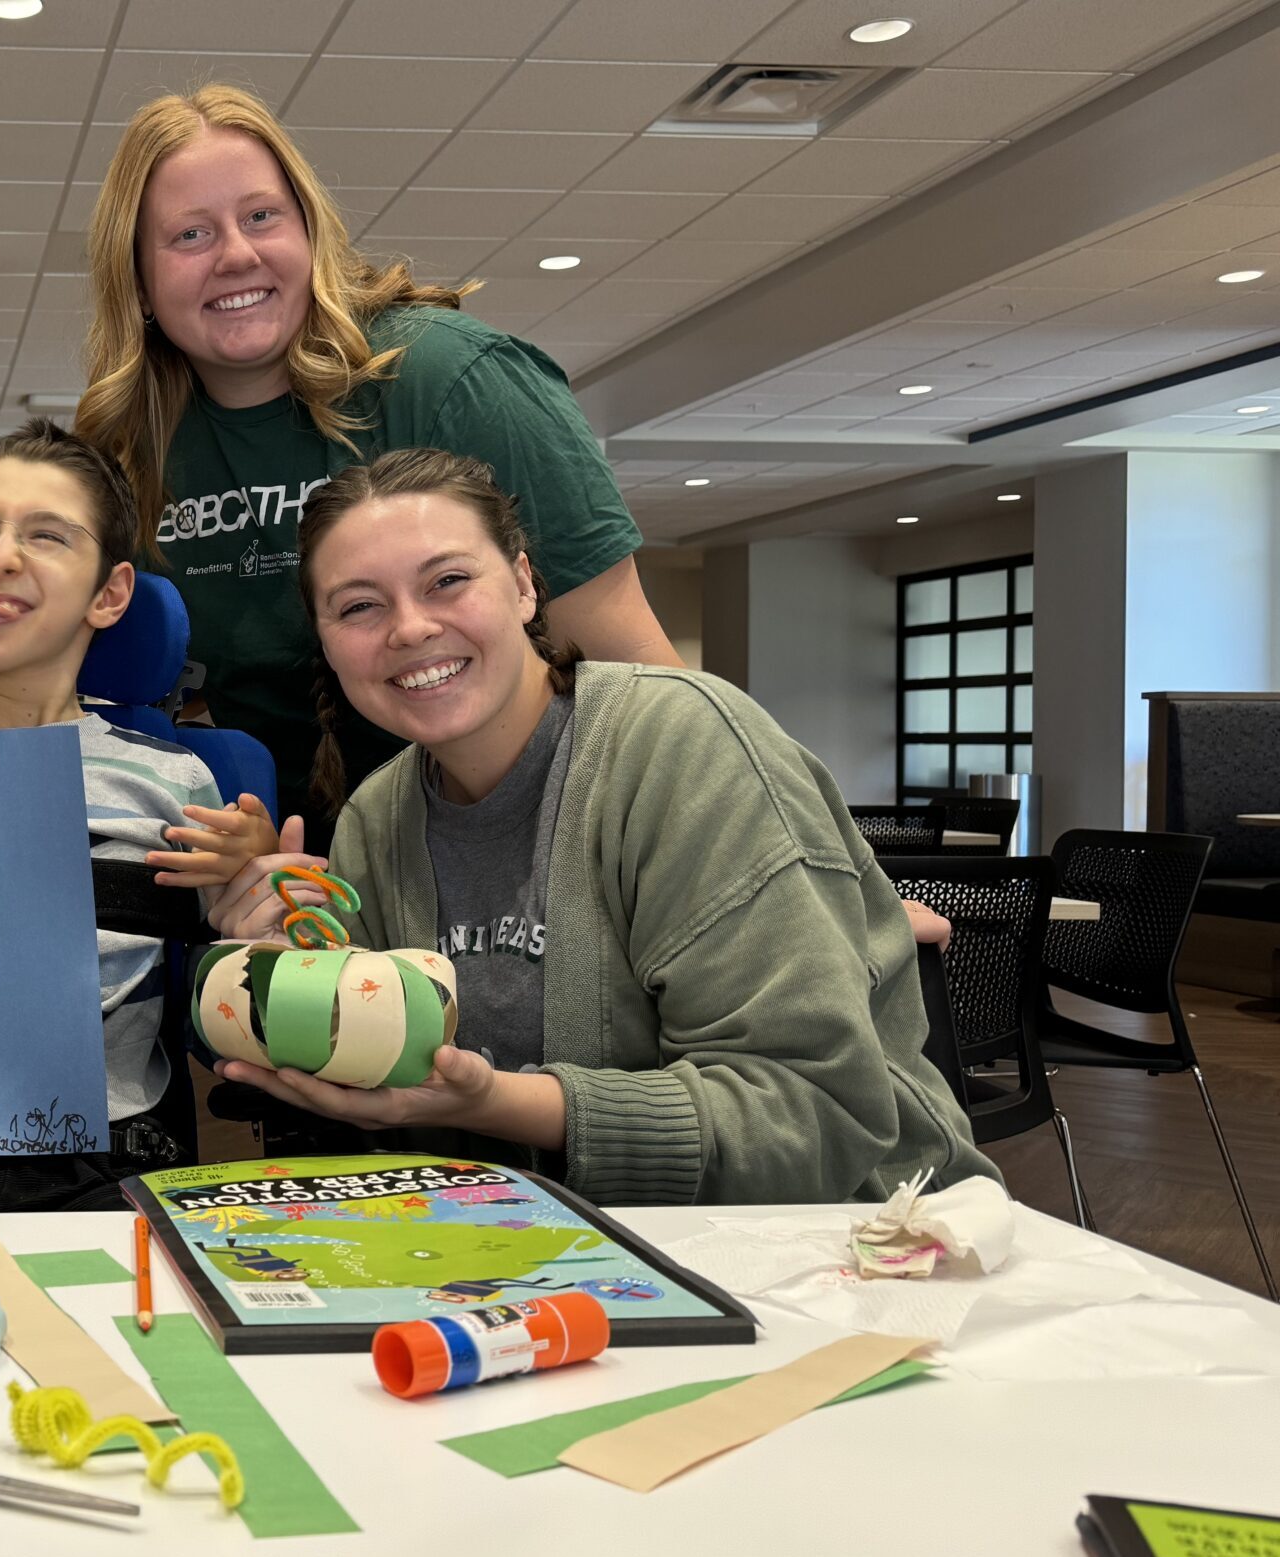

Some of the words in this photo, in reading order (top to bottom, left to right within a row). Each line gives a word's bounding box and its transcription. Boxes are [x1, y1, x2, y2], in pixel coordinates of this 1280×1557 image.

[220, 1179, 304, 1194] PAD
[314, 1167, 446, 1189] PAPER
[181, 1173, 508, 1210] CONSTRUCTION
